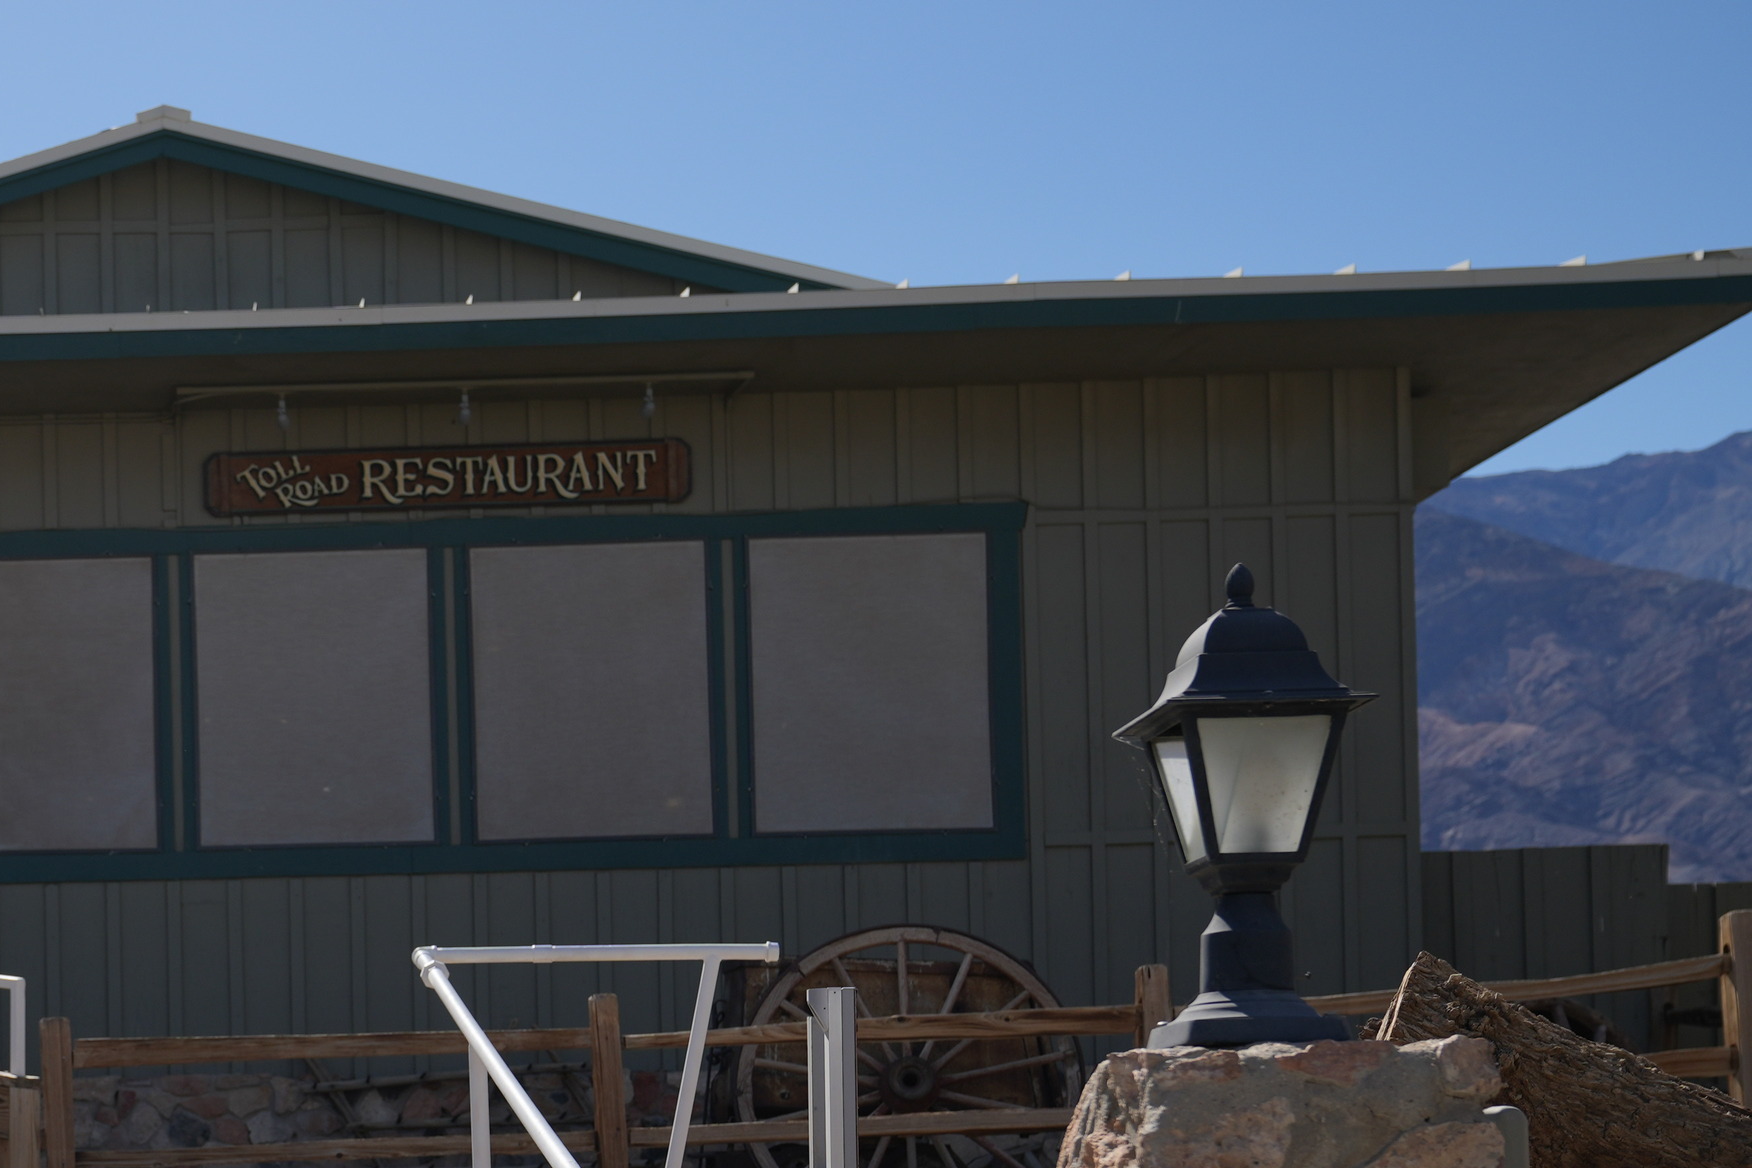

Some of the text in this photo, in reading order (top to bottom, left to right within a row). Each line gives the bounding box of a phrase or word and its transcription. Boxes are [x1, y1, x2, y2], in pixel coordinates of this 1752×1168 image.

[236, 455, 311, 499] TOLL
[274, 449, 657, 508] ROAD RESTAURANT
